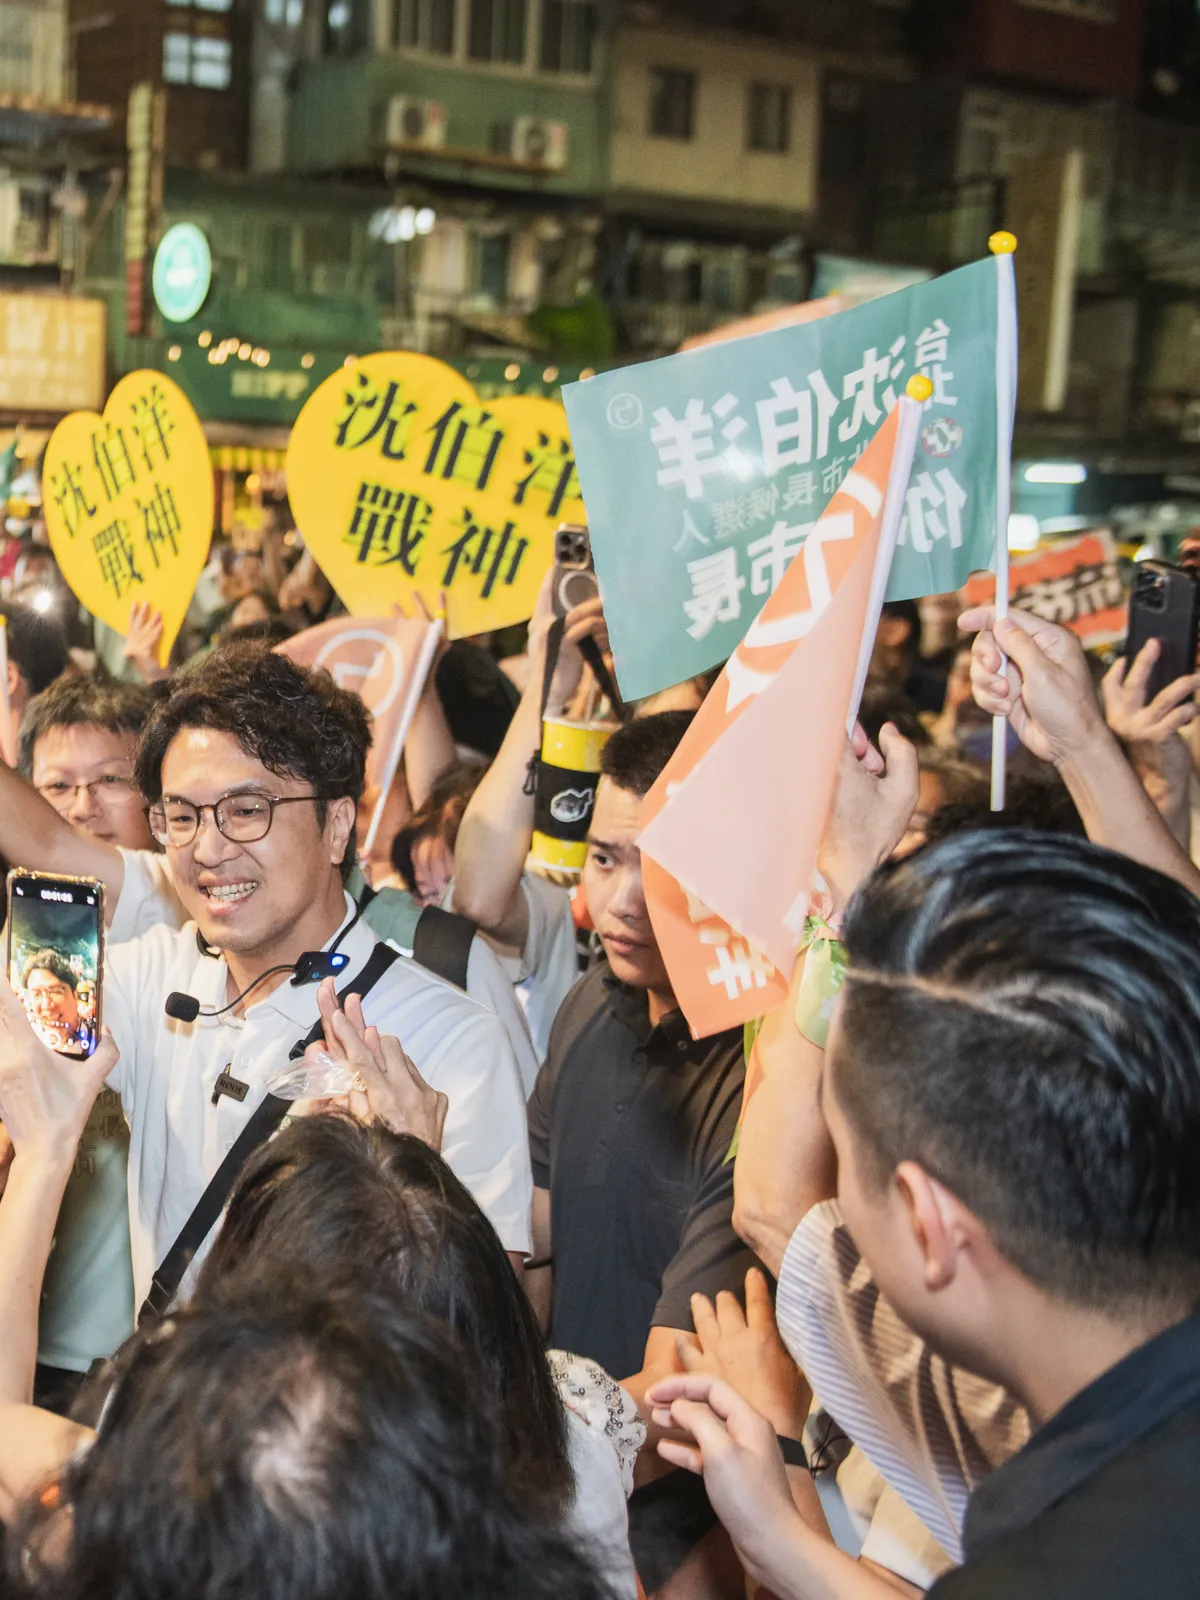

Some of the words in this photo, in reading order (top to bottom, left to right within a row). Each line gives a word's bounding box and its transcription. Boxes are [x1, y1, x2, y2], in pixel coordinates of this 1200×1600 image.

[50, 383, 176, 540] 沈伯洋
[333, 373, 583, 519] 沈伯洋
[92, 482, 182, 600] 戰神
[343, 479, 530, 600] 戰神
